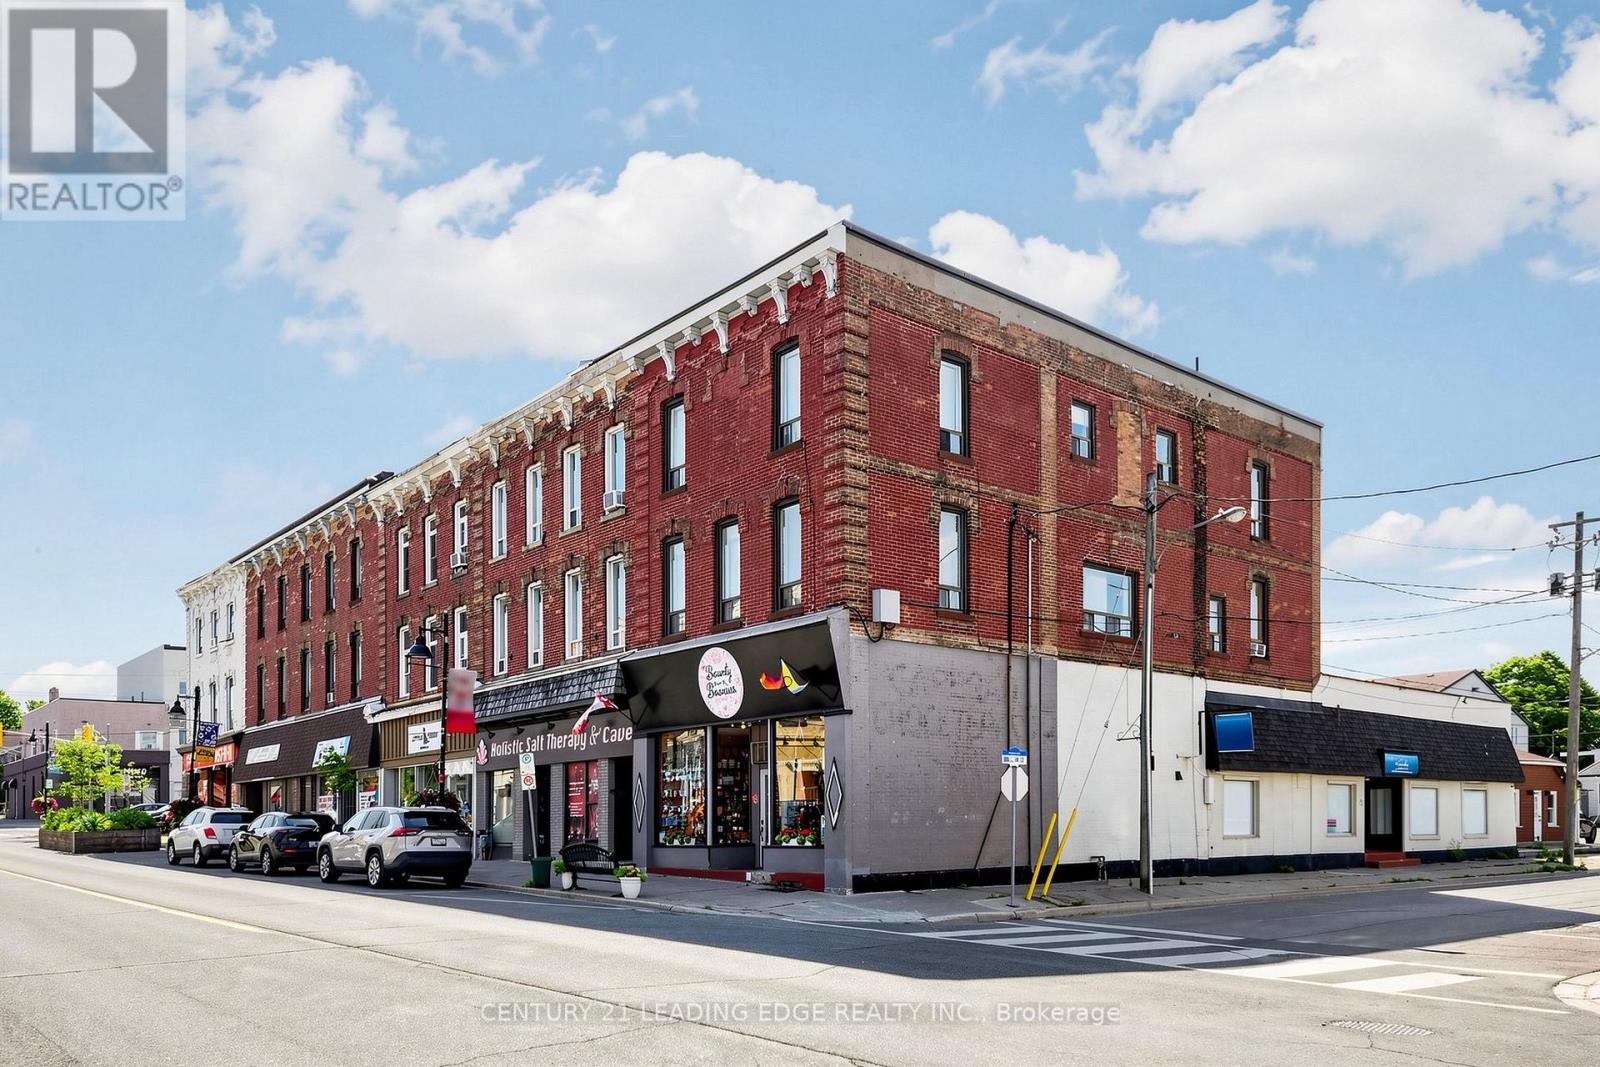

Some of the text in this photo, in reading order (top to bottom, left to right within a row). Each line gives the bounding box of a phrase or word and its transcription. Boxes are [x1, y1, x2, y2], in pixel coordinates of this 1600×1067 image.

[490, 724, 633, 757] Holistic Salt Therapy & Cave
